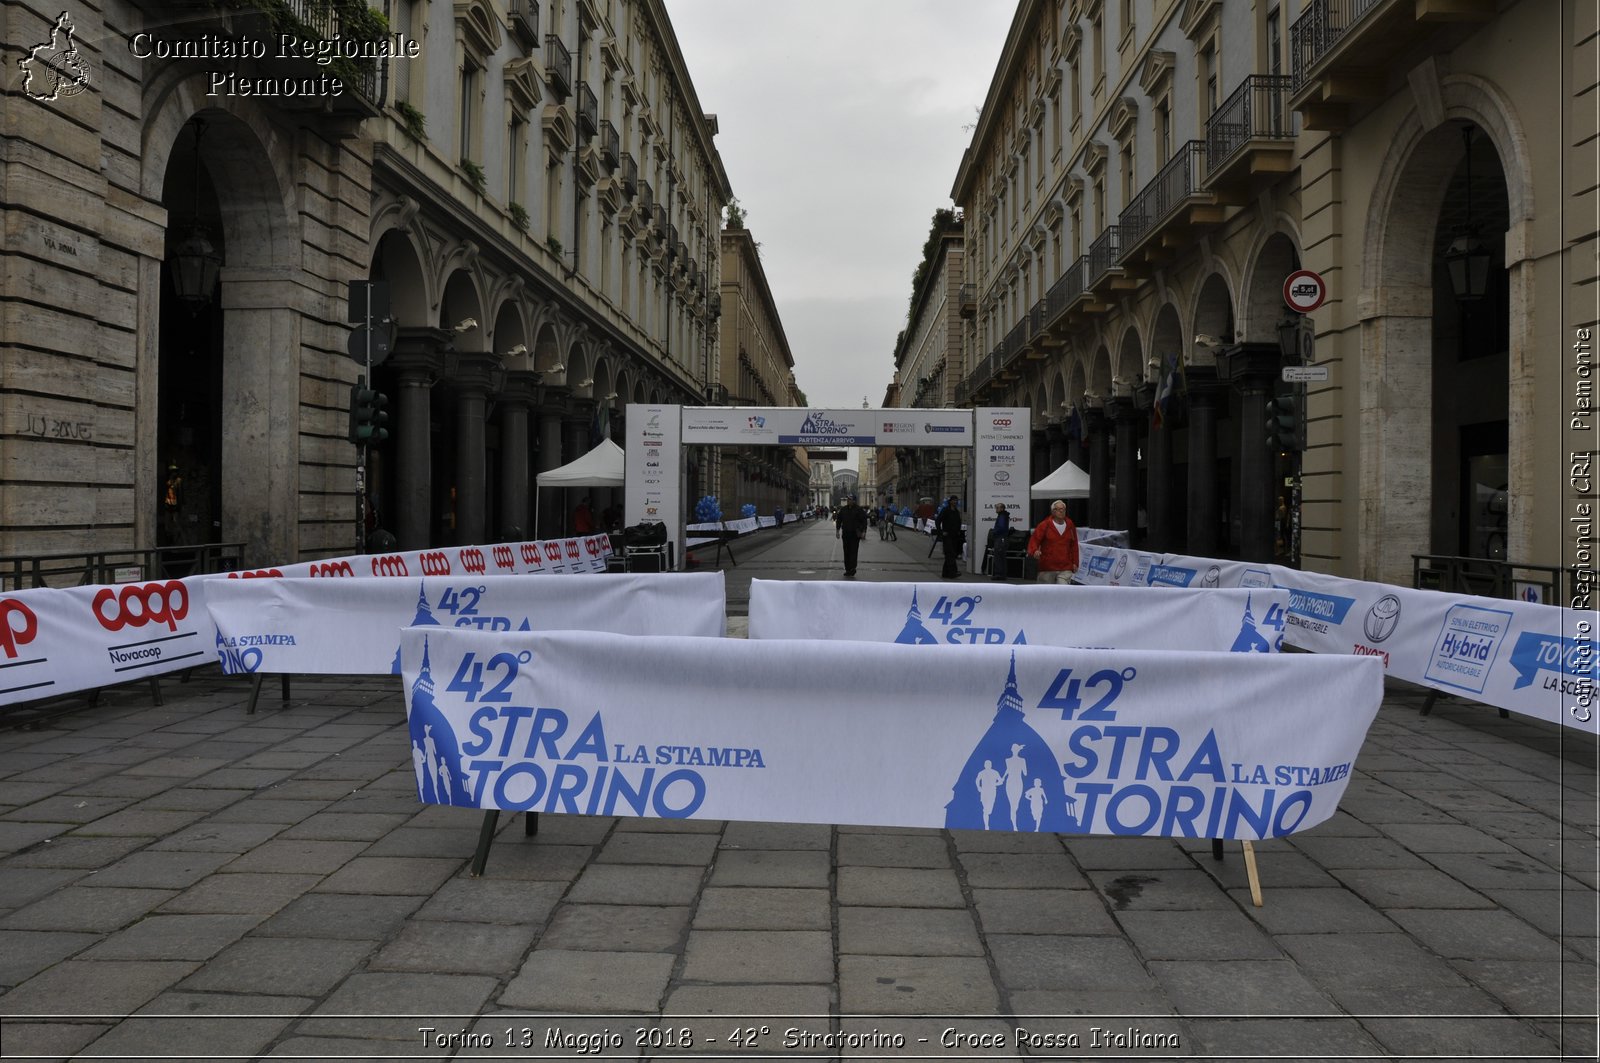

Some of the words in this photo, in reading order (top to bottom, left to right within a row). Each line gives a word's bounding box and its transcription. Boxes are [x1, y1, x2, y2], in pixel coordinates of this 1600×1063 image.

[43, 237, 57, 250] VIA
[815, 419, 835, 427] STRA
[816, 426, 848, 434] TORINO
[993, 419, 1012, 428] coop
[419, 551, 451, 576] coop
[459, 548, 486, 575] coop
[493, 546, 515, 573] coop
[520, 544, 542, 568] coop
[91, 579, 190, 632] coop
[437, 585, 486, 615] 42°
[928, 595, 982, 626] 42°
[1468, 620, 1500, 634] ELETTRICO
[239, 634, 296, 647] STAMPA
[1440, 632, 1494, 661] Hybrid
[109, 645, 162, 665] Novacoop
[446, 650, 532, 703] 42°
[1543, 676, 1558, 691] LA
[1036, 666, 1137, 721] 42°
[461, 706, 609, 762] STRA
[613, 744, 650, 765] LA
[655, 745, 766, 768] STAMPA
[1063, 724, 1226, 783] STRA
[1231, 763, 1270, 785] LA
[1274, 763, 1351, 787] STAMPA
[467, 760, 706, 820] TORINO
[1074, 783, 1313, 840] TORINO
